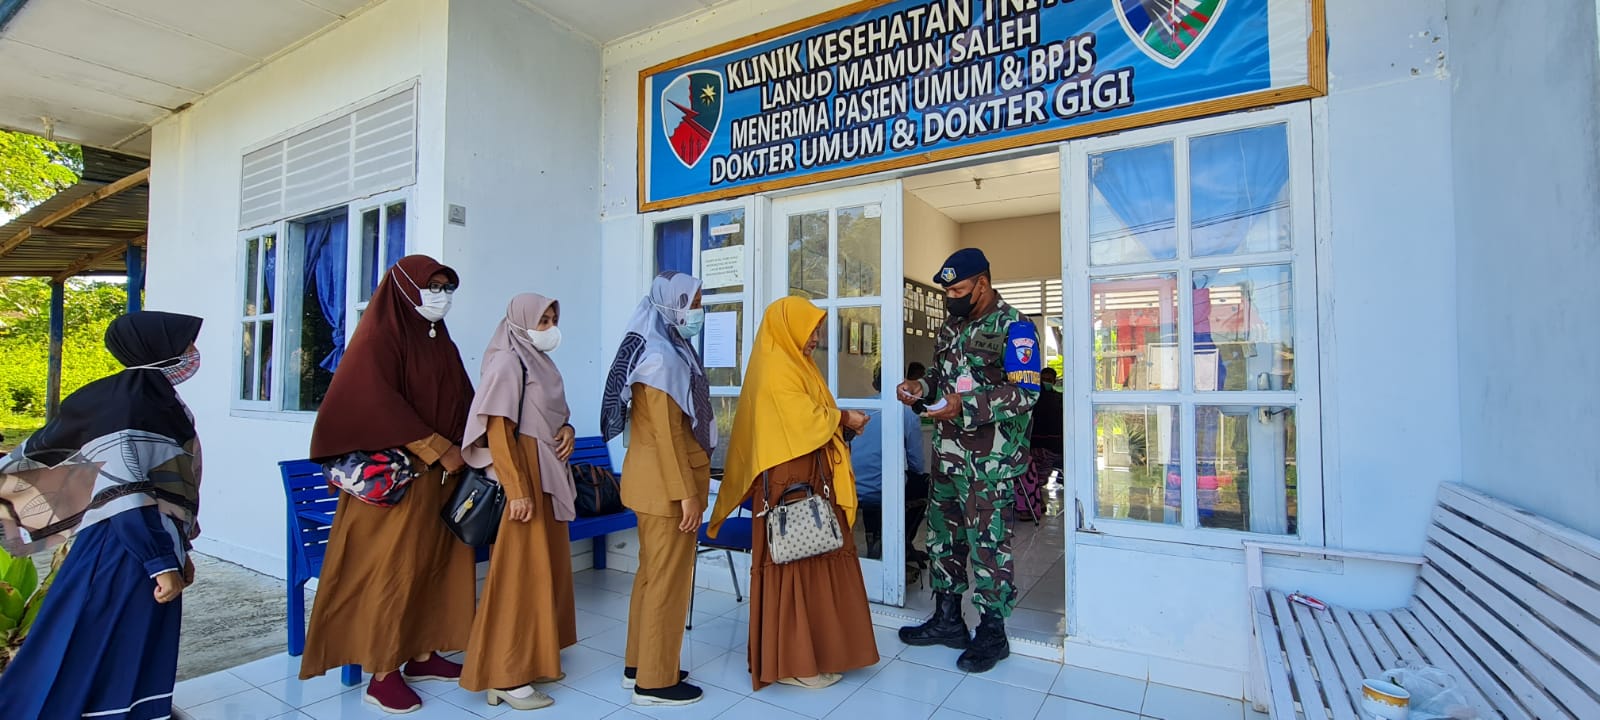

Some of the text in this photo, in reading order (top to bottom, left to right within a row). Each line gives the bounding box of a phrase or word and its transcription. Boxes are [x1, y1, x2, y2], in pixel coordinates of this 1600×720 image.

[727, 43, 802, 91] KLINIK
[808, 0, 970, 70] KESEHATAN
[732, 36, 1093, 149] MENERIMA PASIEN UMUM & BPJS
[762, 14, 1037, 110] LANUD MAIMUN SALEH
[711, 70, 1131, 183] DOKTER UMUM & DOKTER GIGI
